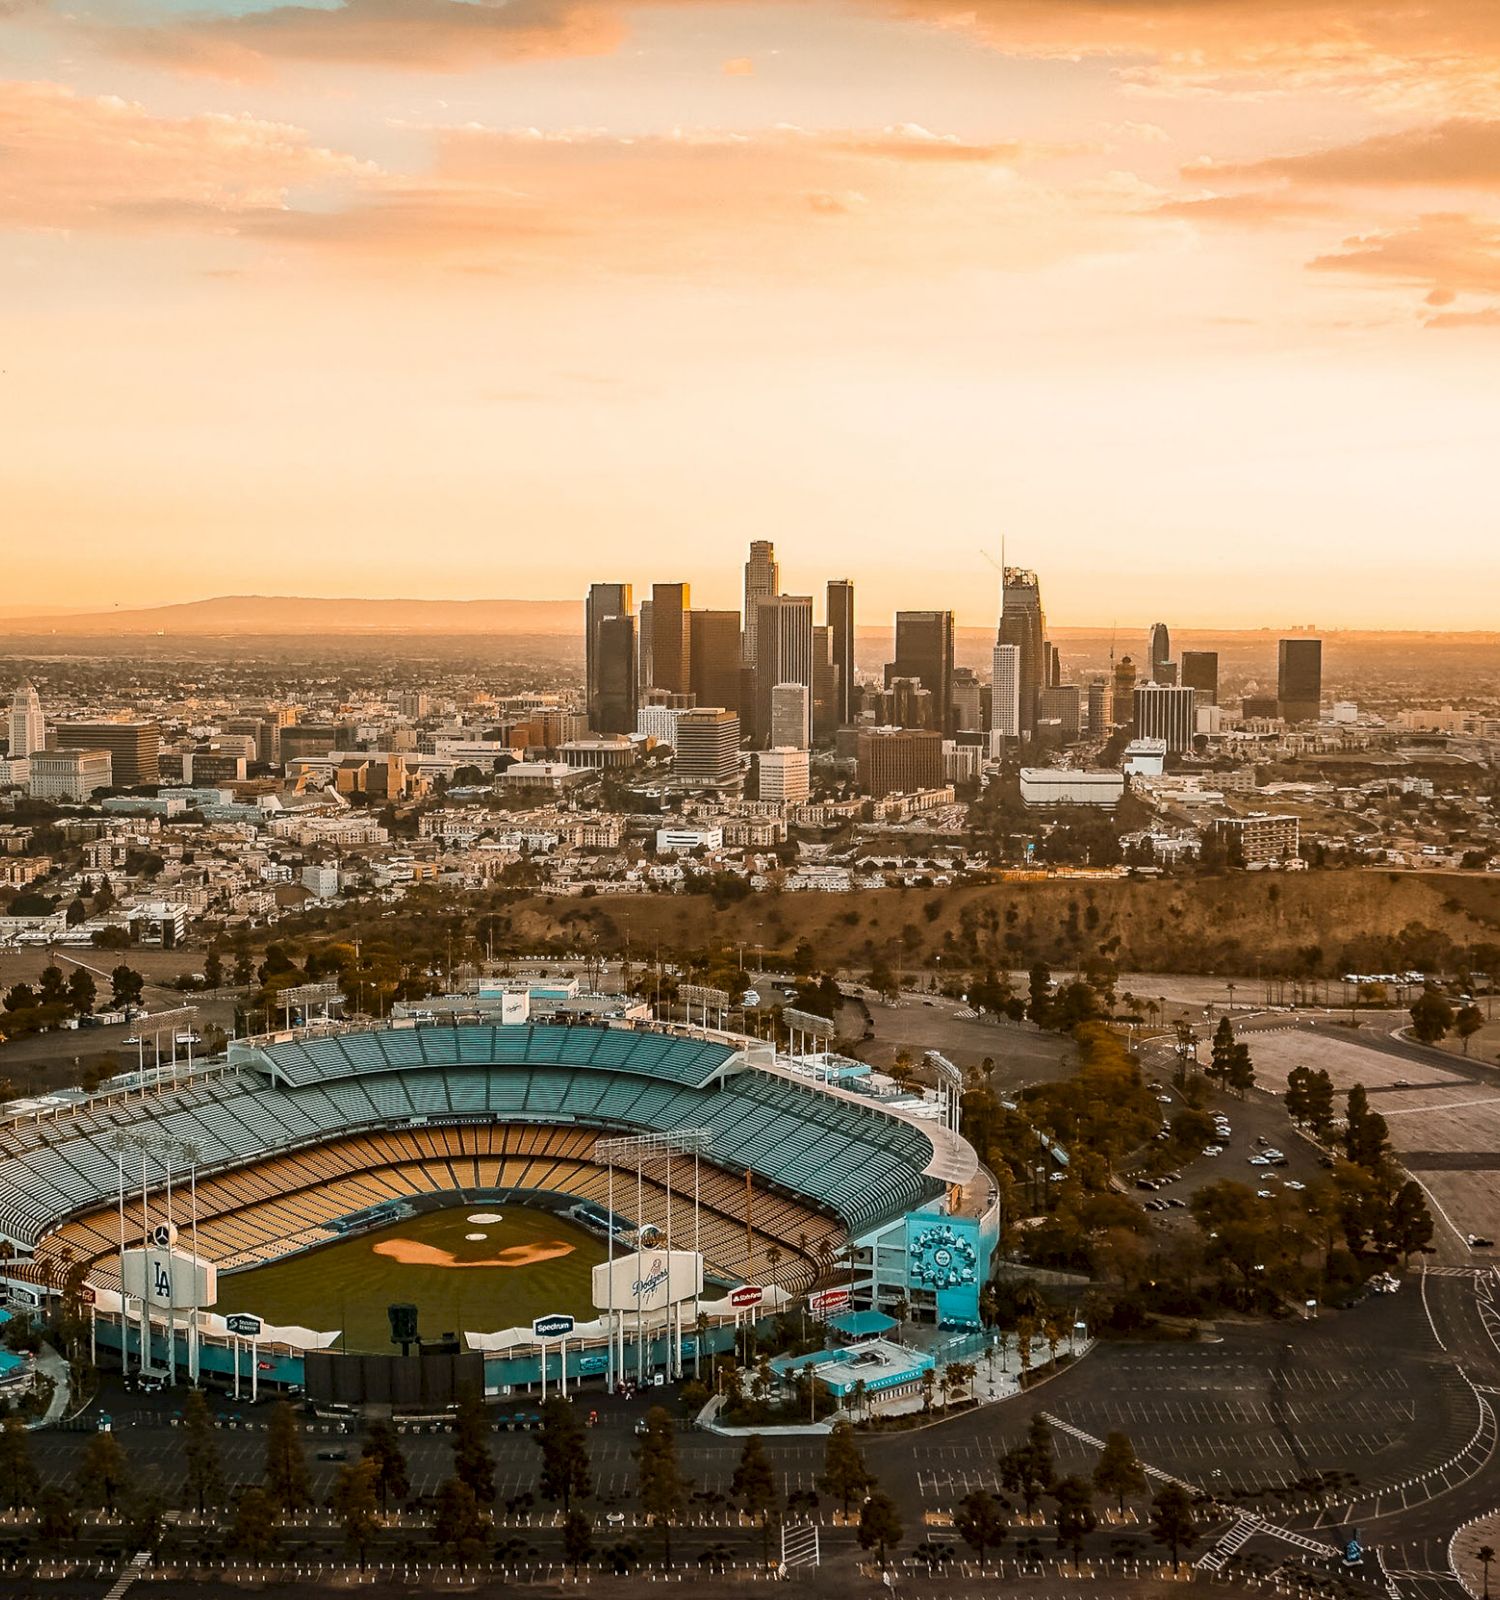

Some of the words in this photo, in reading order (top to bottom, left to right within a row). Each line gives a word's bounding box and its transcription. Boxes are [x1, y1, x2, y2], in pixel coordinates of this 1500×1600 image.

[154, 1261, 170, 1297] LA
[632, 1268, 669, 1296] Dodgers
[537, 1322, 570, 1333] Spectrum
